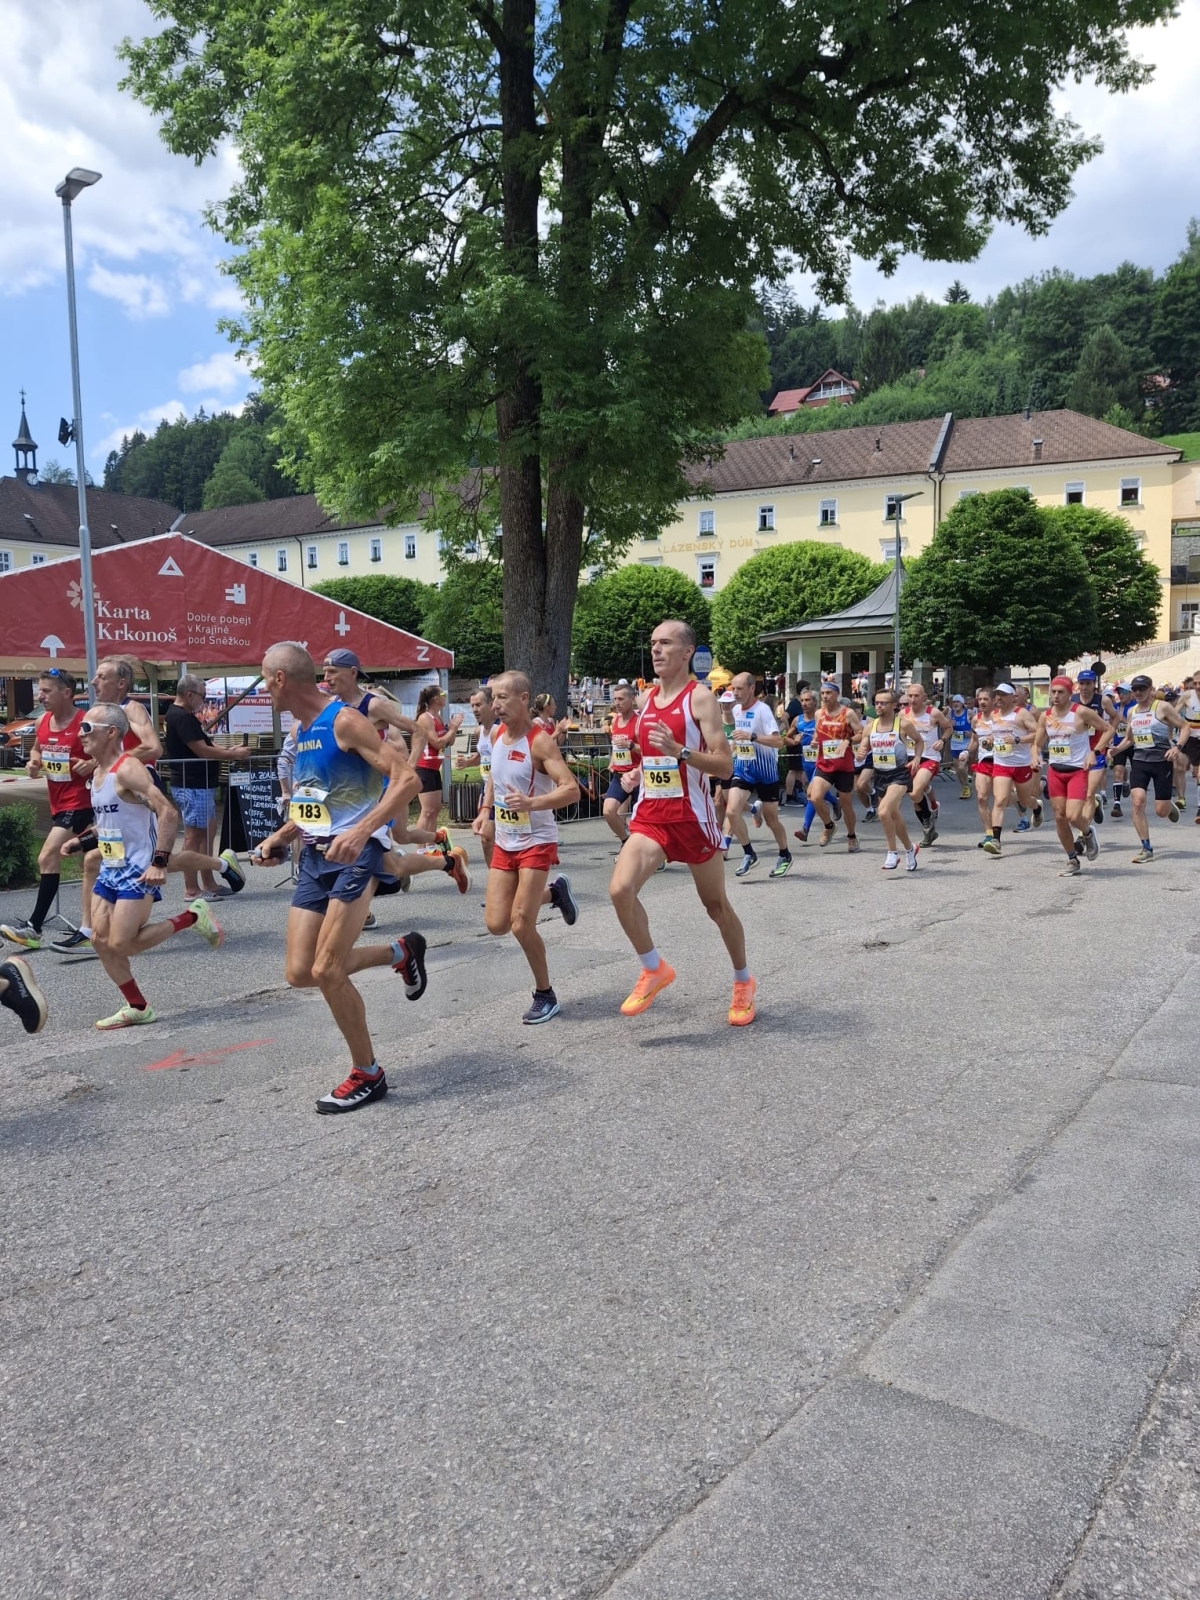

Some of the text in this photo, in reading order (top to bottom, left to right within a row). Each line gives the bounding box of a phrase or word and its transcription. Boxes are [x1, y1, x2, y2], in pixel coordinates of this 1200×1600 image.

[97, 600, 151, 620] Karta
[187, 612, 252, 625] Dobře pobejt
[97, 622, 177, 642] Krkonoš
[195, 624, 229, 636] Krajině
[188, 636, 251, 646] pod Sněžkou
[47, 762, 62, 771] 419
[650, 771, 671, 784] 965
[298, 803, 322, 819] 183
[500, 808, 519, 821] 214
